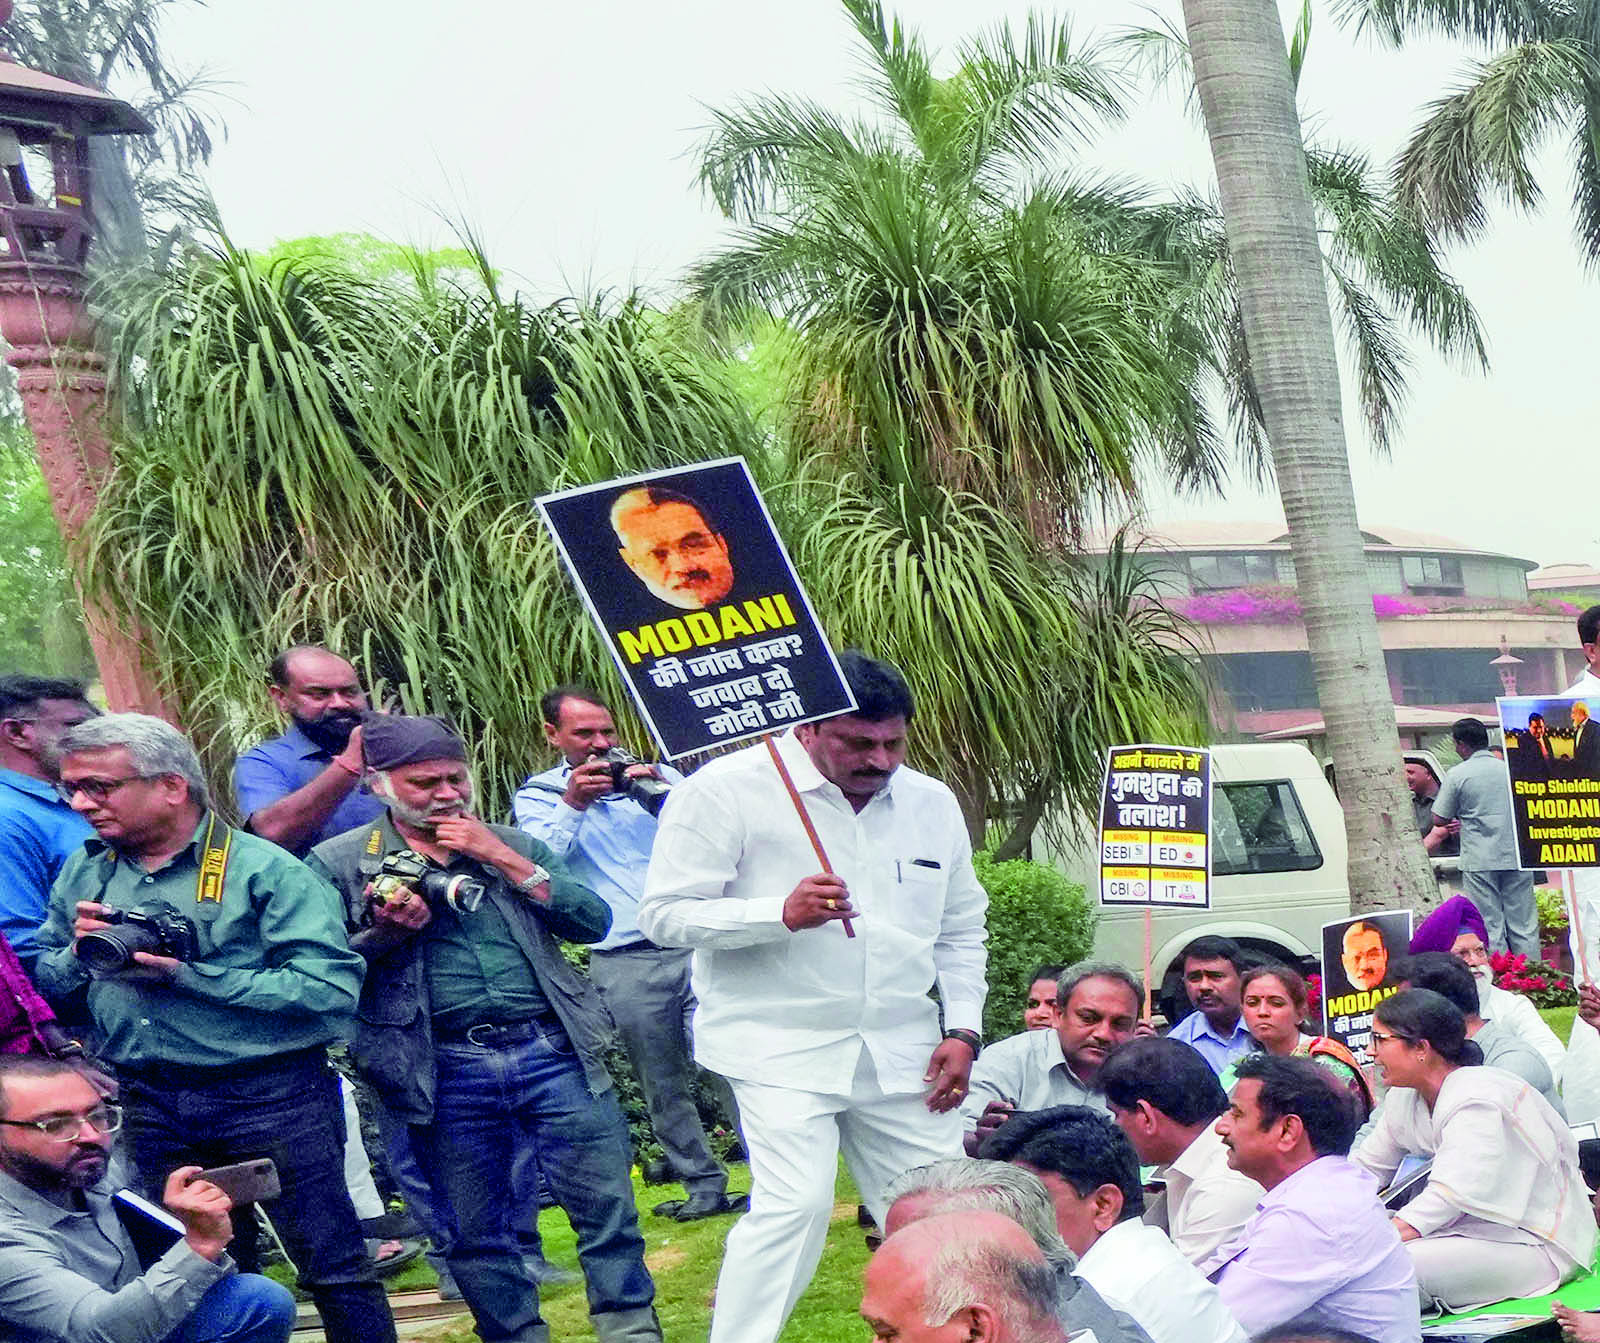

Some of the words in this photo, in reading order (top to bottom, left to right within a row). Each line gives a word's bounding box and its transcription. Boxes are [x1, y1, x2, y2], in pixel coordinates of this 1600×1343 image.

[617, 593, 797, 664] MODANI
[648, 657, 689, 688] की
[686, 646, 743, 680] जांच
[742, 634, 804, 665] कब?
[688, 679, 762, 711] जवाब
[762, 664, 794, 692] दो
[704, 702, 769, 737] मोदी
[769, 692, 806, 720] जी
[1111, 772, 1181, 802] गुमशुदा
[1180, 776, 1203, 798] की
[1515, 780, 1546, 796] Stop
[1527, 799, 1600, 819] MODANI
[1104, 846, 1131, 859] SEBI
[1160, 847, 1177, 860] ED
[1540, 844, 1596, 863] ADANI
[1110, 882, 1129, 896] CBI
[1165, 885, 1177, 898] IT
